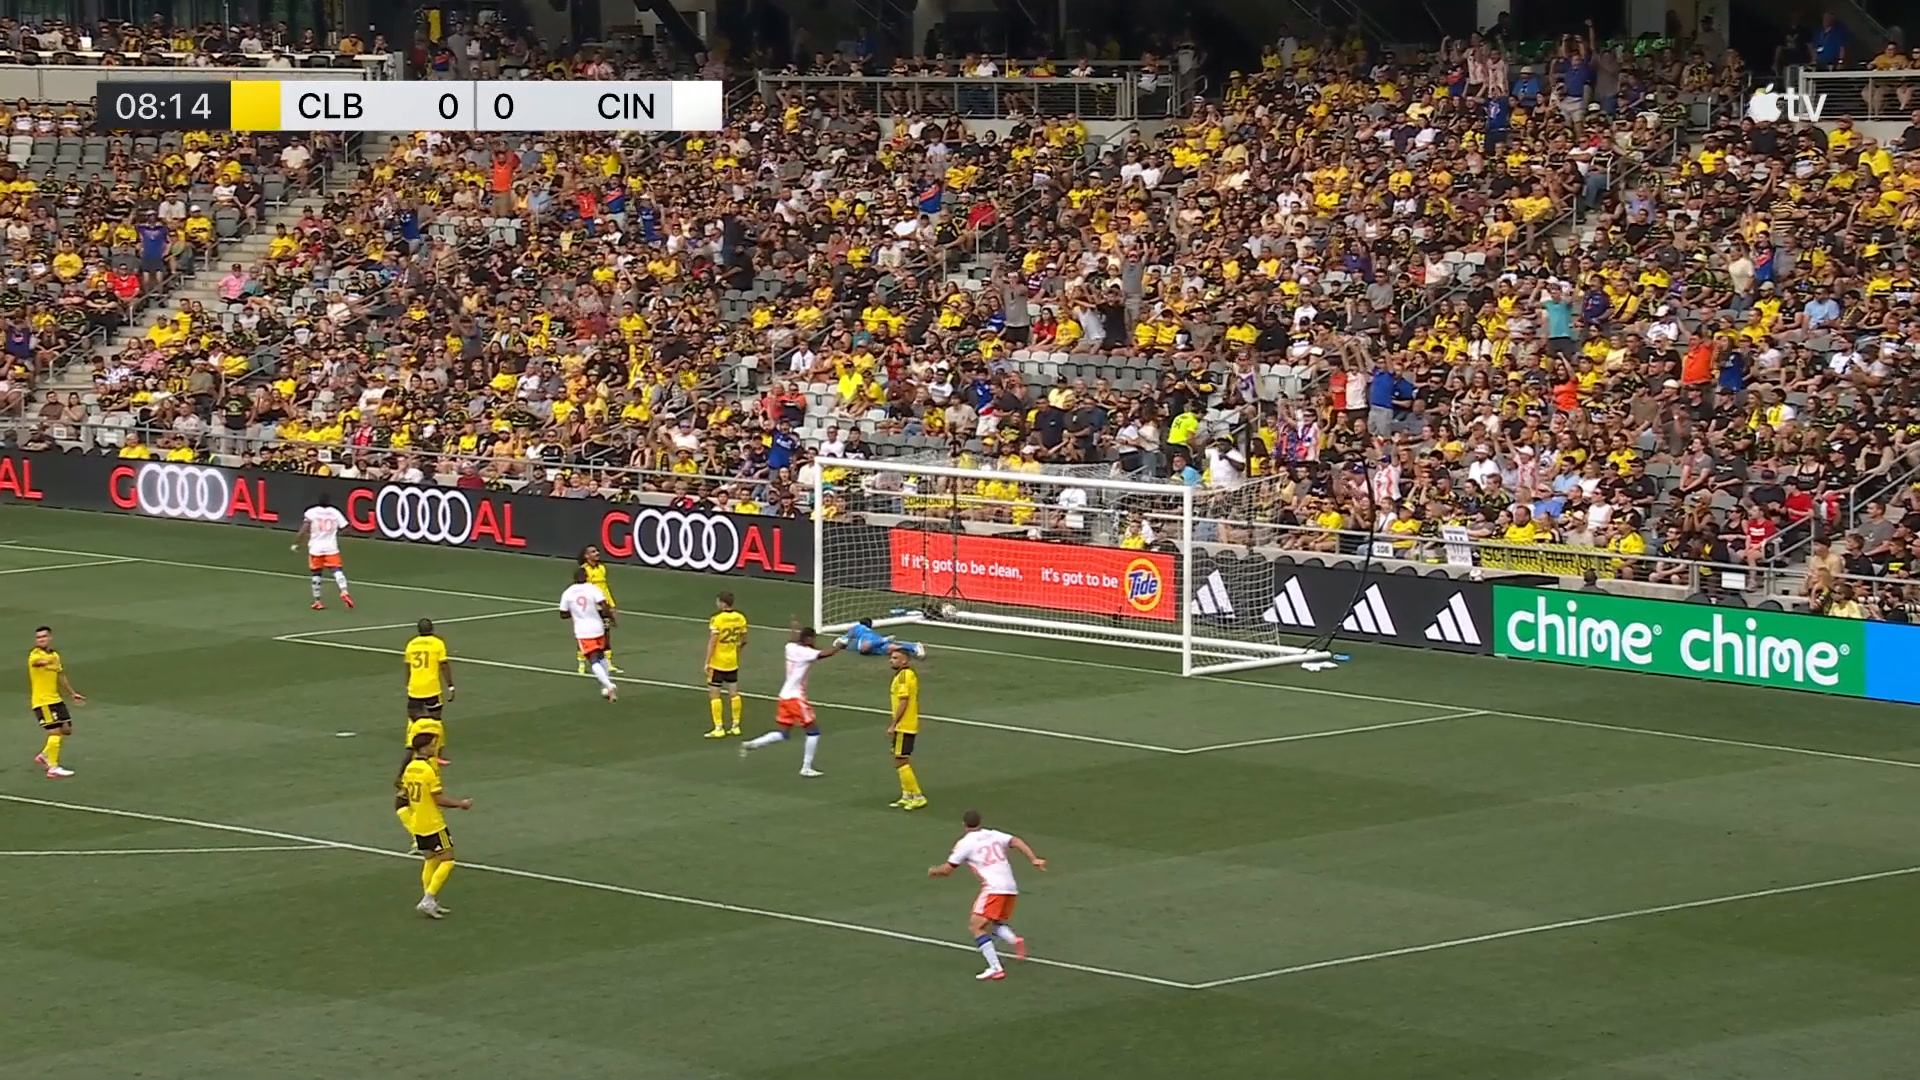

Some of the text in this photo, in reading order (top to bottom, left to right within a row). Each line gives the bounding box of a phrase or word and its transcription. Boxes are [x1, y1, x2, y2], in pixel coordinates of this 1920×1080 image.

[901, 553, 1160, 600] If it's got to be clean, it's got to be Tide
[576, 596, 587, 612] 9
[719, 627, 741, 644] 25
[411, 650, 430, 669] 31
[978, 841, 1008, 867] 20
